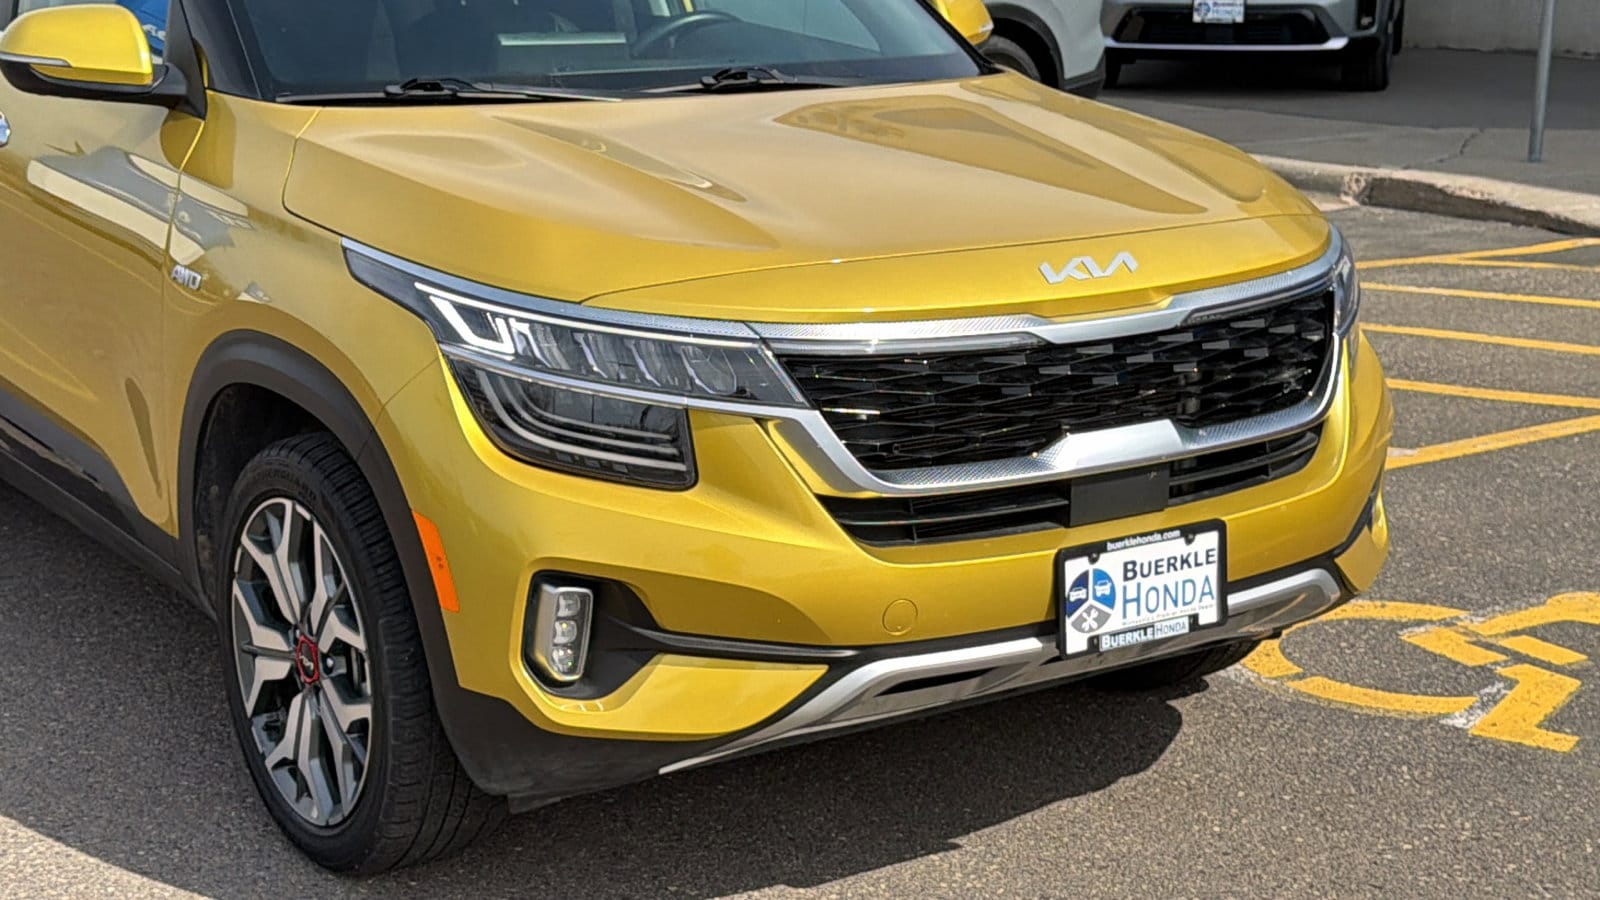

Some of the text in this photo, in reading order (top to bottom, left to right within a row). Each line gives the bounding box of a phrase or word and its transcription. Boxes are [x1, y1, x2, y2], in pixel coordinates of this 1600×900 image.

[171, 264, 202, 290] AWD
[1039, 251, 1138, 285] KIA
[1106, 530, 1181, 551] buerklehonda.com
[1123, 548, 1217, 582] BUERKLE
[1122, 575, 1215, 619] HONDA
[1102, 622, 1187, 648] BUERKLE HONDA
